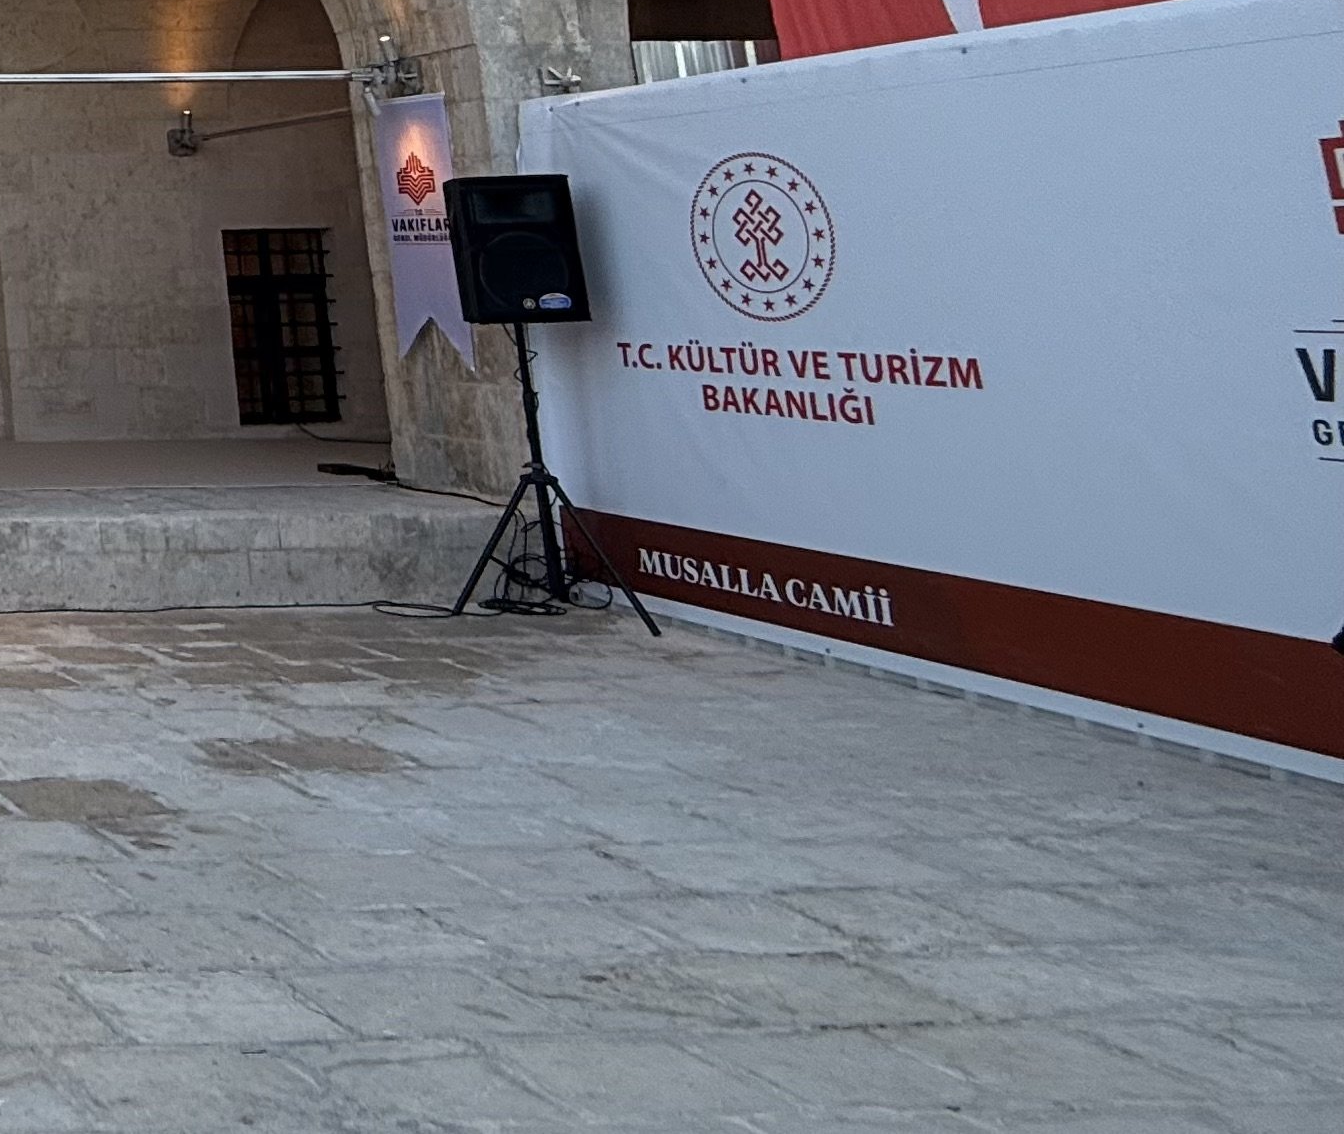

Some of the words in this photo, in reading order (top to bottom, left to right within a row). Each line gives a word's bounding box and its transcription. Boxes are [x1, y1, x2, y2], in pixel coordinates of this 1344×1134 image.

[392, 218, 451, 232] VAKIFLAR
[617, 342, 662, 370] T.C.
[667, 339, 782, 377] KÜLTÜR
[788, 350, 831, 380] VE
[837, 348, 984, 390] TURİZM
[702, 384, 876, 426] BAKANLIĞI
[638, 548, 783, 602] MUSALLA
